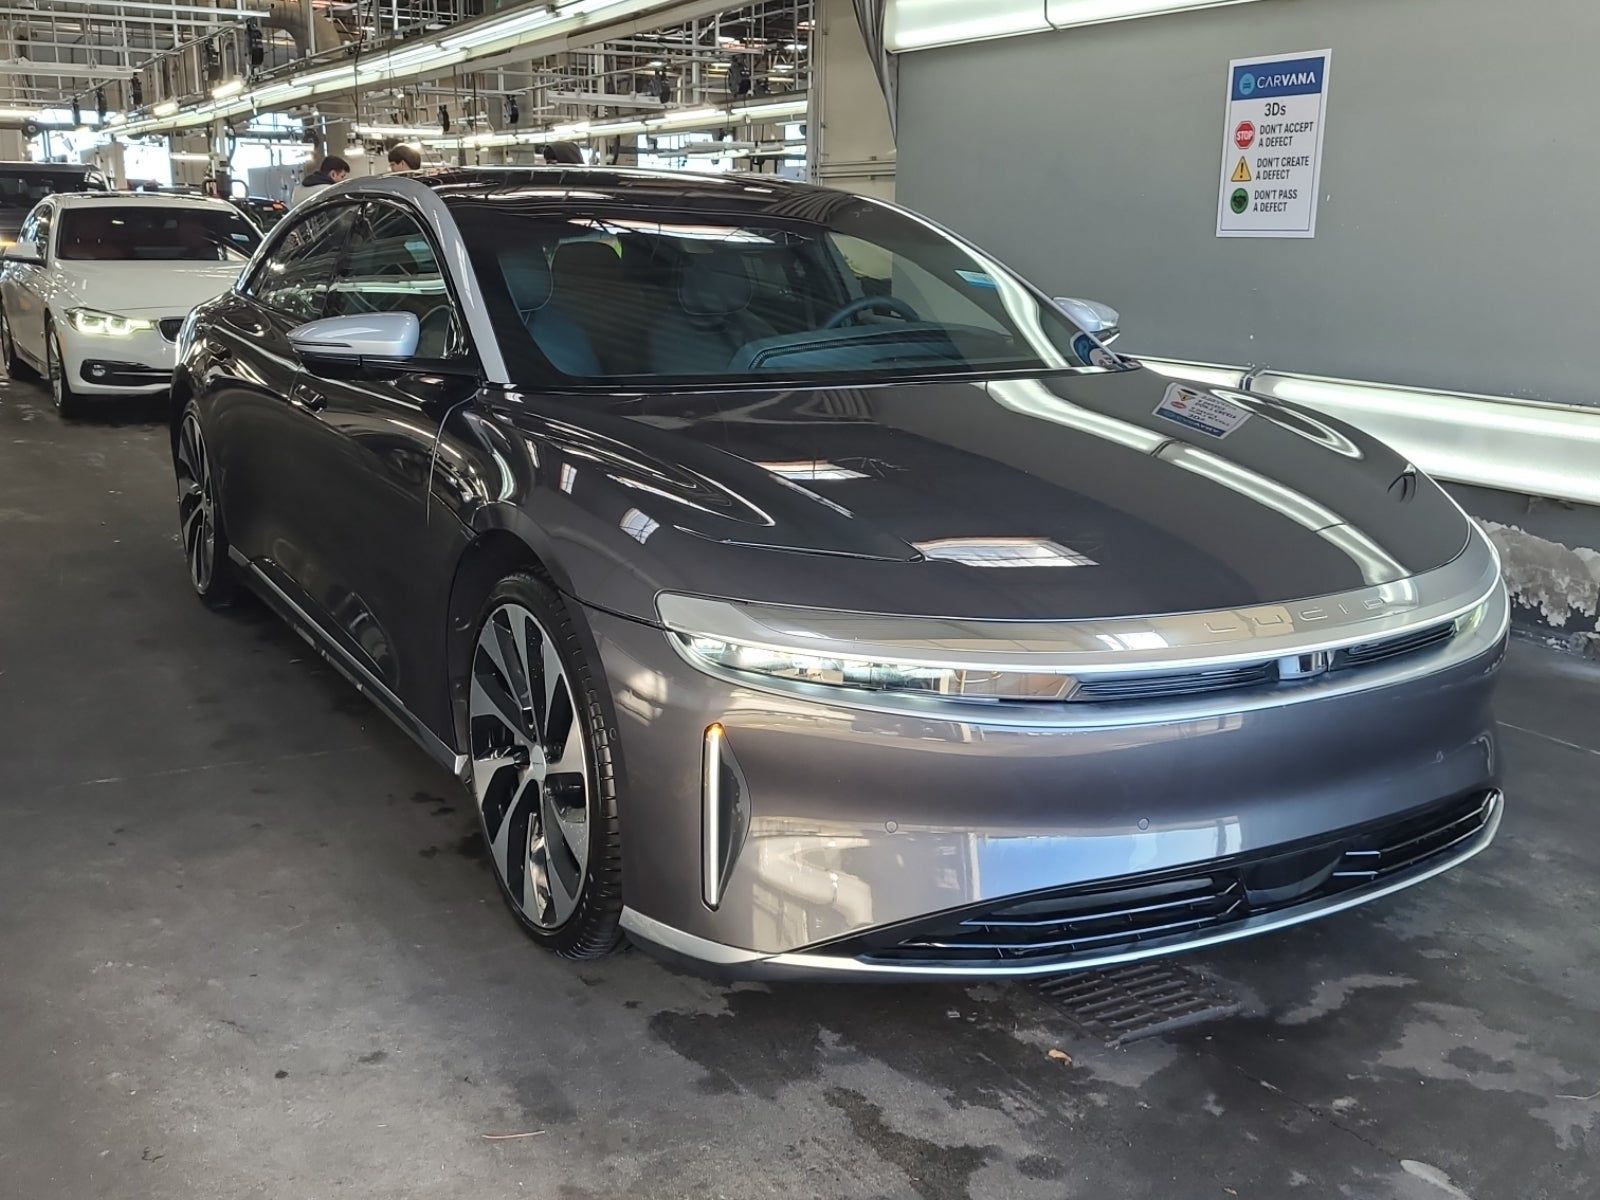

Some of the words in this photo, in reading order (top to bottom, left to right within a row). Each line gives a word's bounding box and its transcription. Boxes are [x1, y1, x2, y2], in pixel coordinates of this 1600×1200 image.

[1257, 72, 1315, 89] CARVANA
[1265, 102, 1286, 116] 3Ds
[1260, 124, 1283, 134] DON'T
[1284, 122, 1314, 133] ACCEPT
[1237, 130, 1253, 141] STOP
[1259, 138, 1264, 147] A
[1266, 136, 1293, 147] DEFECT
[1257, 158, 1279, 168] DON'T
[1281, 156, 1309, 167] CREATE
[1256, 171, 1261, 180] A
[1263, 170, 1290, 180] DEFECT
[1254, 190, 1276, 200] DON'T
[1278, 189, 1298, 199] PASS
[1253, 203, 1258, 212] A
[1260, 202, 1287, 212] DEFECT
[1204, 597, 1385, 633] LUCID
